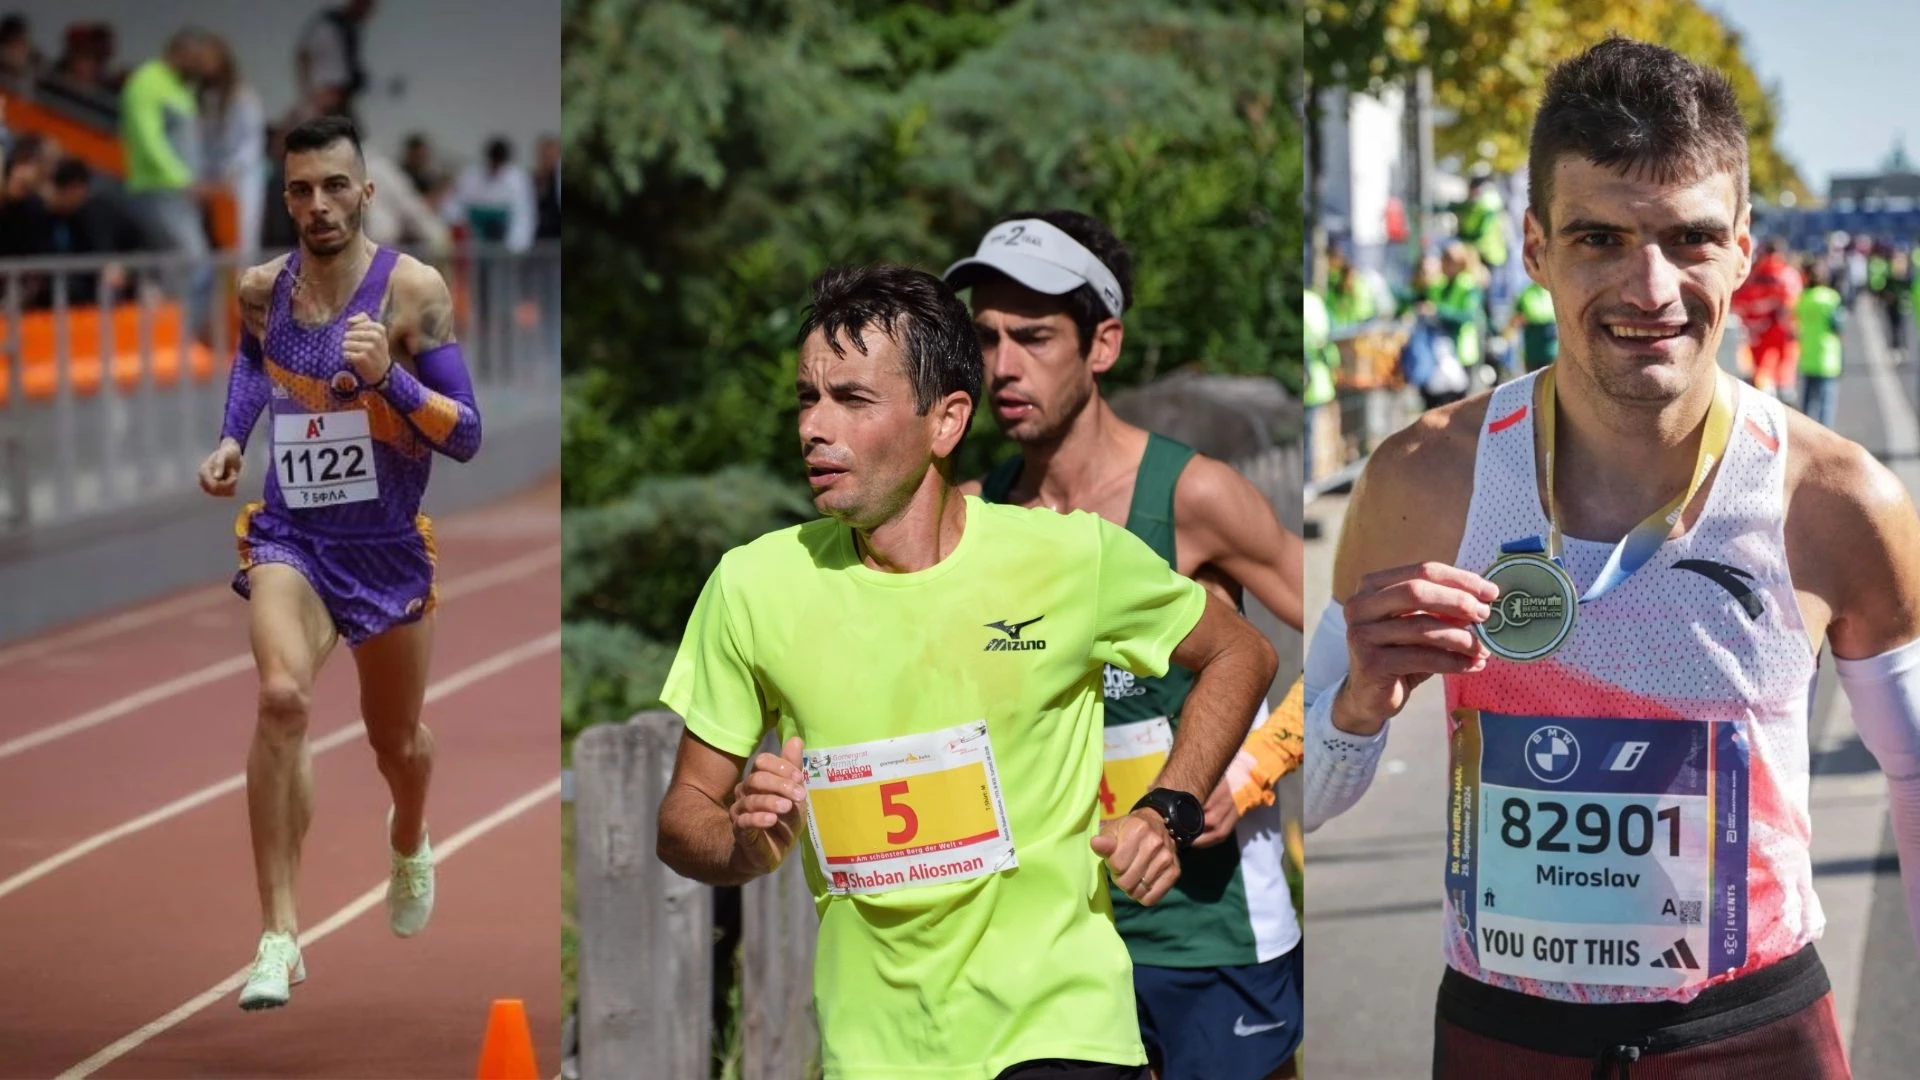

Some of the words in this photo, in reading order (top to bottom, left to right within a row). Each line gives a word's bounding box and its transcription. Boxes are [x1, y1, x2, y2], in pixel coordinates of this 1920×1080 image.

[281, 444, 367, 483] 1122
[312, 489, 348, 504] БФЛА
[1522, 597, 1547, 606] BMW
[1532, 728, 1573, 745] BMW
[827, 764, 872, 777] Marathon
[1463, 785, 1472, 810] 2024
[879, 780, 919, 845] 5
[1462, 810, 1471, 860] September
[1501, 797, 1680, 857] 82901
[869, 850, 905, 860] schönsten
[906, 847, 923, 856] Berg
[938, 842, 956, 850] Welt
[848, 868, 905, 889] Shaban
[909, 856, 984, 882] Aliosman
[1536, 864, 1640, 888] Miroslav
[1661, 898, 1678, 916] A
[1726, 884, 1736, 926] EVENTS
[1482, 927, 1524, 958] YOU
[1533, 936, 1578, 964] GOT
[1584, 939, 1640, 967] THIS
